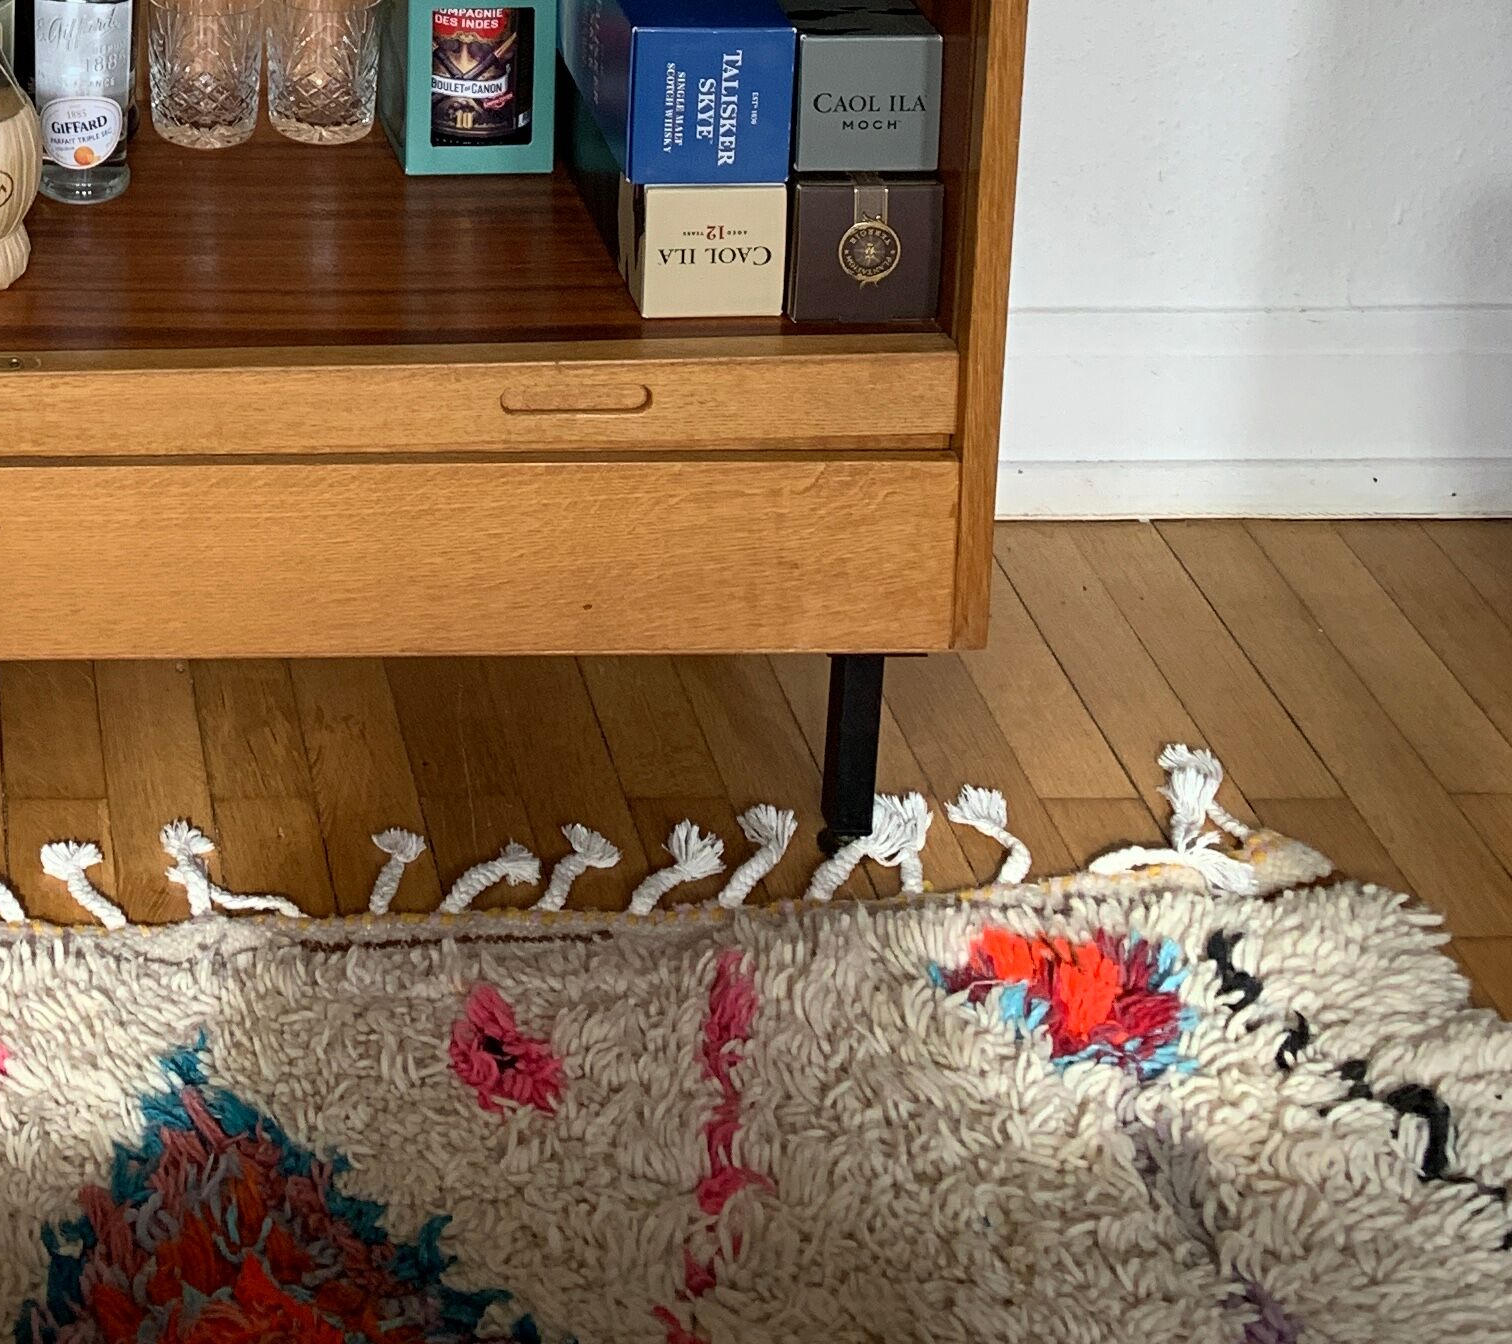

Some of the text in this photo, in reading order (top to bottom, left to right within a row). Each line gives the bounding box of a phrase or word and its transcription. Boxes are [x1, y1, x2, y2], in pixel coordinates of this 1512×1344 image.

[434, 14, 499, 29] DES INDES
[436, 7, 504, 19] OMPAGNIE
[431, 76, 465, 93] BOULET
[471, 82, 503, 94] CANON
[663, 62, 676, 153] SCOTCH WHISKY
[674, 71, 686, 146] SINGLE MALT
[696, 78, 716, 140] SKYE
[717, 49, 743, 166] TALISKER
[813, 92, 926, 113] CAOL ILA
[51, 115, 108, 134] GIFFARD
[842, 119, 897, 130] MOCH
[50, 136, 75, 145] PARFAIT
[78, 133, 101, 144] TRIPLE
[705, 225, 725, 241] 12
[657, 245, 772, 266] CAOL ILA
